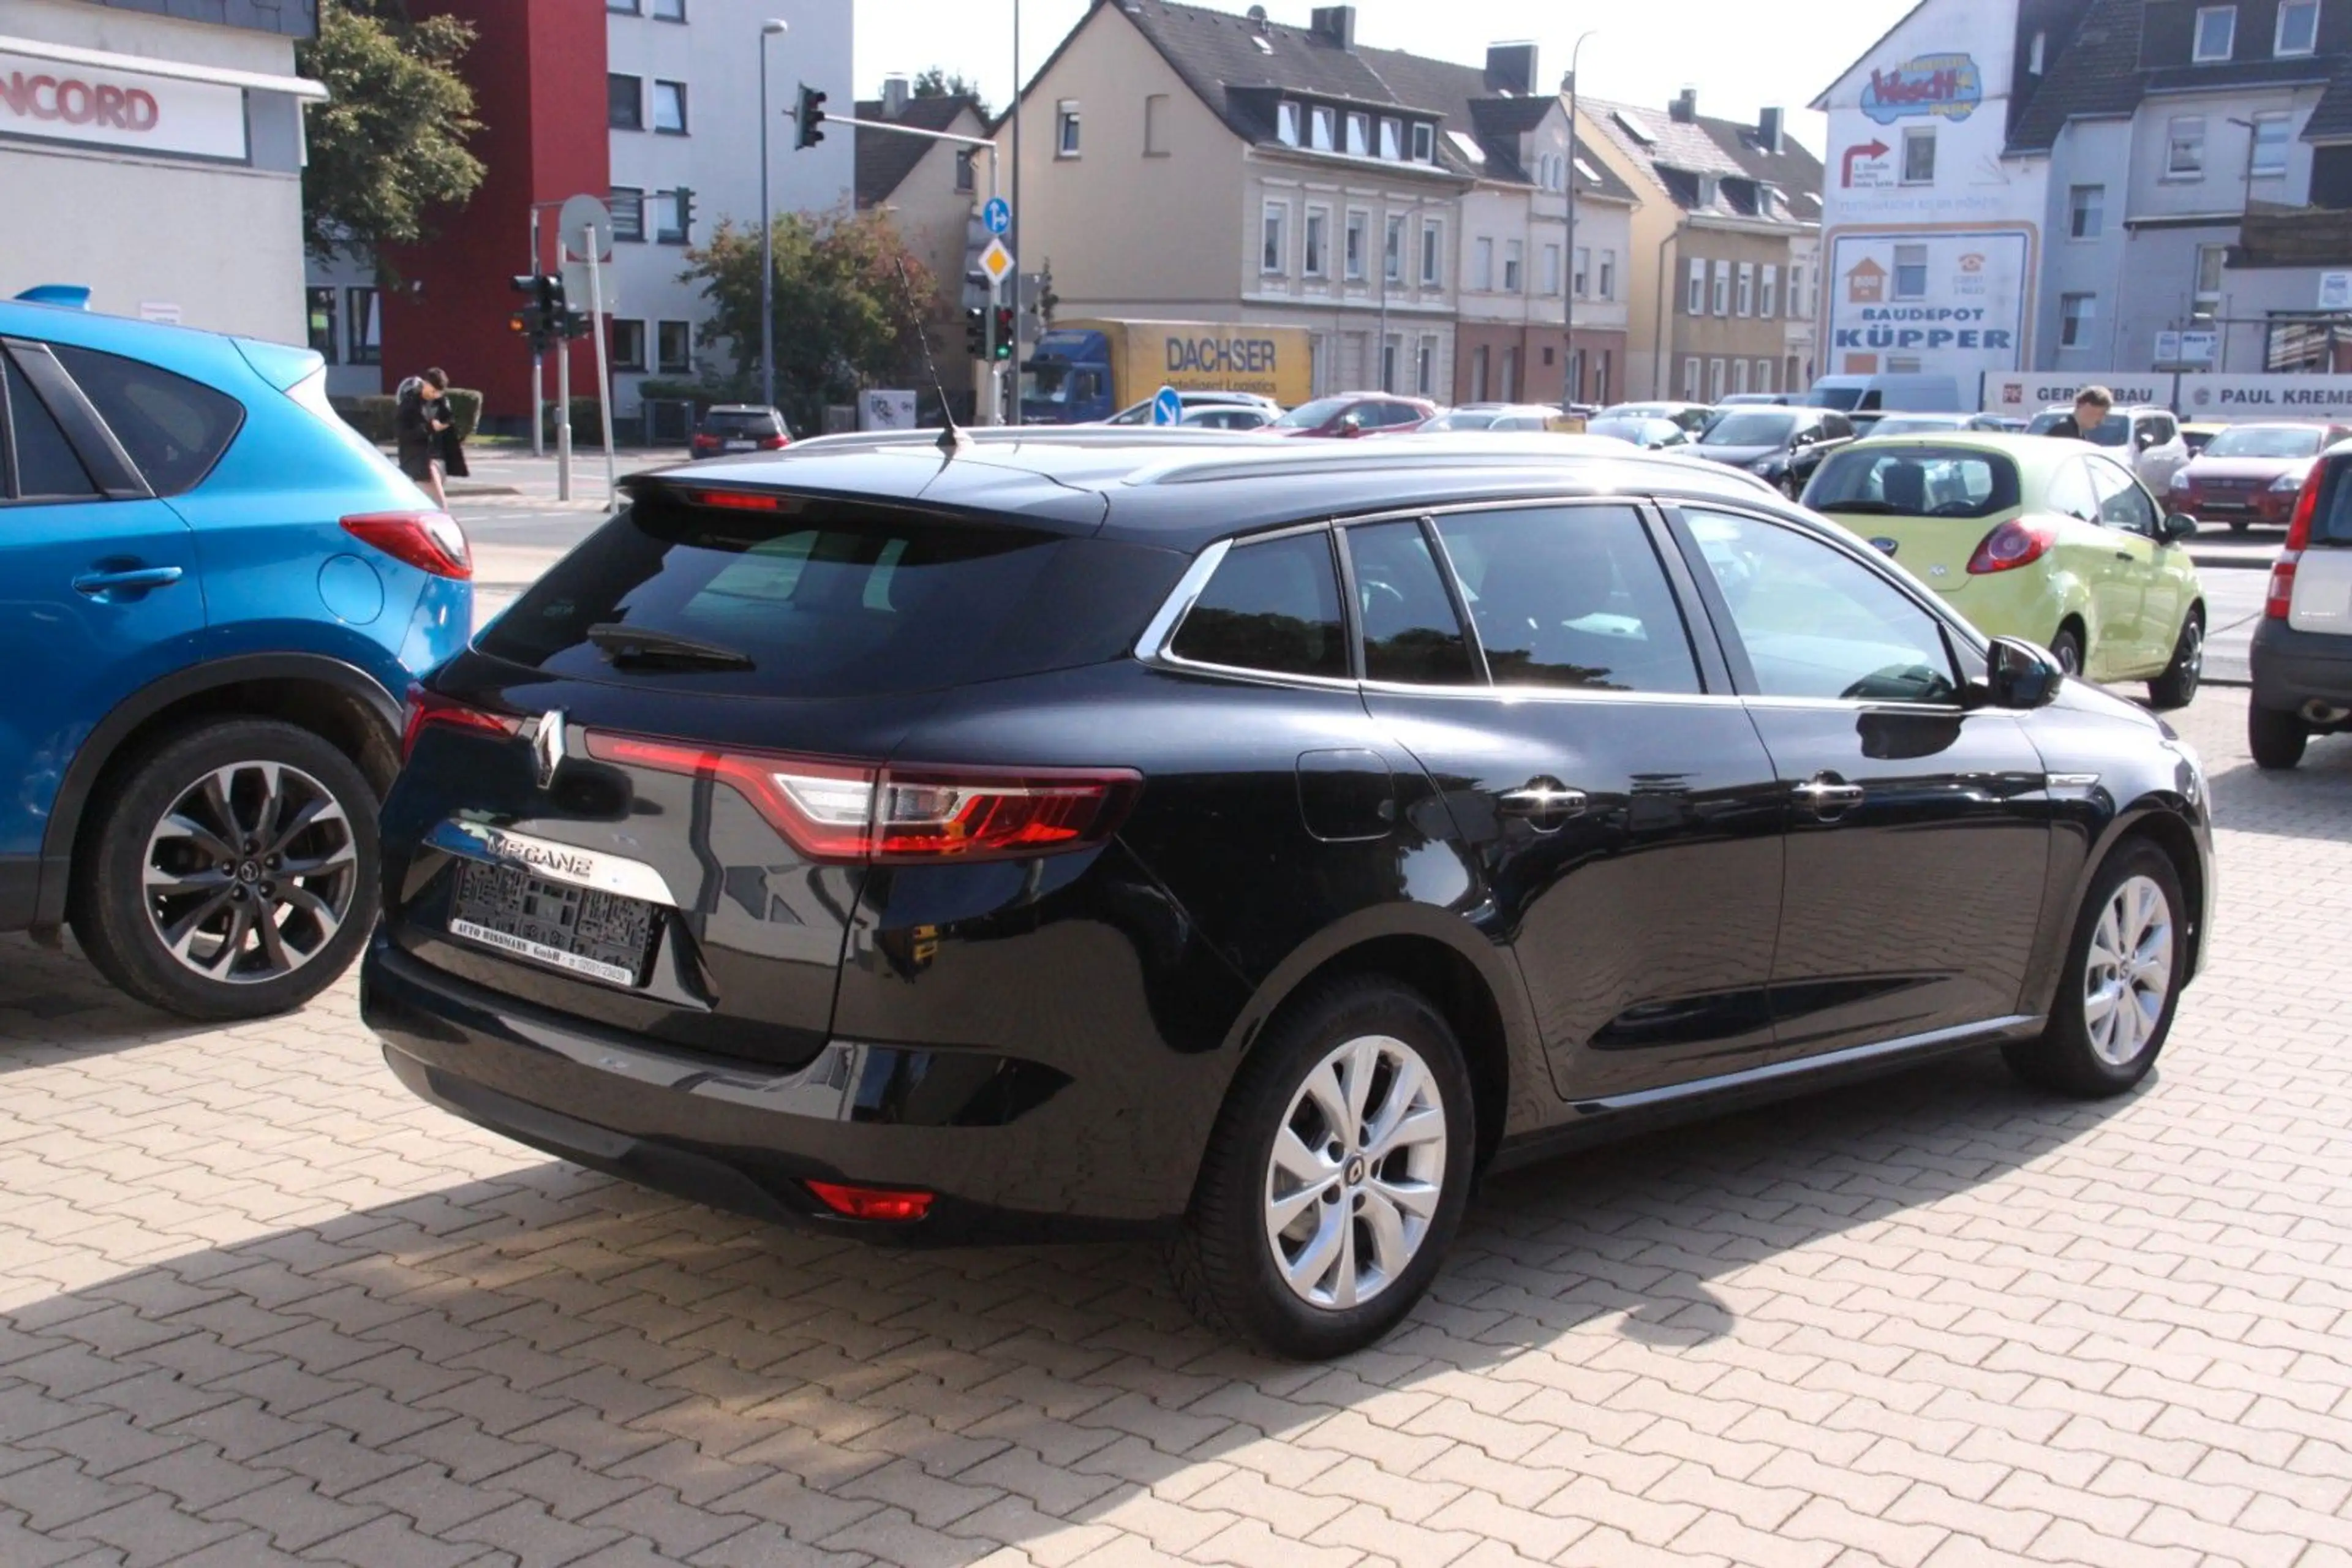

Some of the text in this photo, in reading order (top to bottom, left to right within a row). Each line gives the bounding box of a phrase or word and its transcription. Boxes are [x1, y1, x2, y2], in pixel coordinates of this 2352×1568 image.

[1862, 307, 1985, 322] BAUDEPOT
[1836, 324, 2011, 349] KÜPPER
[1166, 337, 1276, 372] DACHSER
[2036, 383, 2154, 402] GERBAU
[2220, 388, 2276, 405] PAUL
[488, 834, 593, 878] MEGANE
